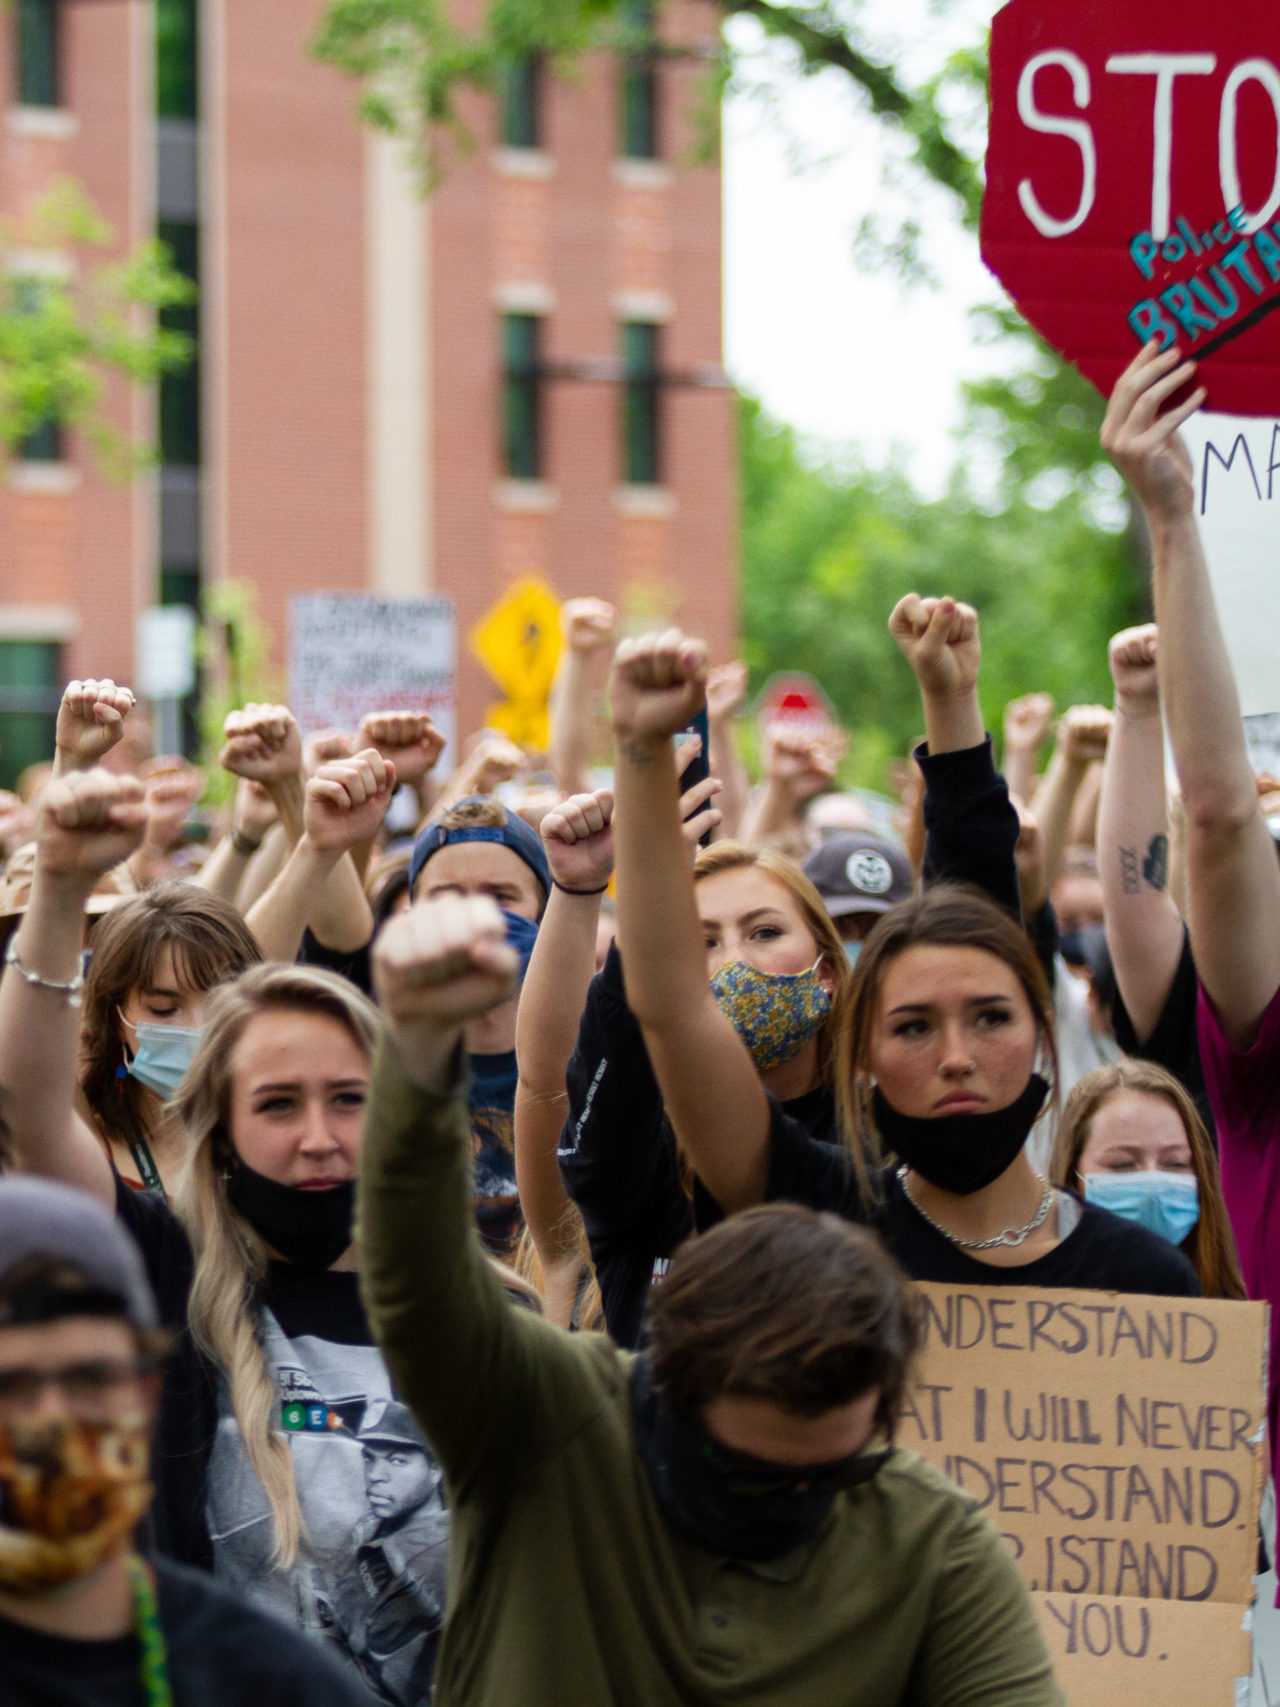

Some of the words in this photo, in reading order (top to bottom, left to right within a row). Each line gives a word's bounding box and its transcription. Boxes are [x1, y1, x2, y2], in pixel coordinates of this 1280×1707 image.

[1128, 219, 1280, 352] BRUTA
[920, 1293, 1218, 1364] NDERSTAND
[312, 1410, 323, 1425] E
[898, 1383, 952, 1442] AT
[974, 1387, 987, 1442] I
[1003, 1389, 1101, 1445] WILL
[1116, 1393, 1257, 1457] NEVER
[945, 1455, 1247, 1530] DERSTAND.
[1045, 1599, 1168, 1661] YOU.
